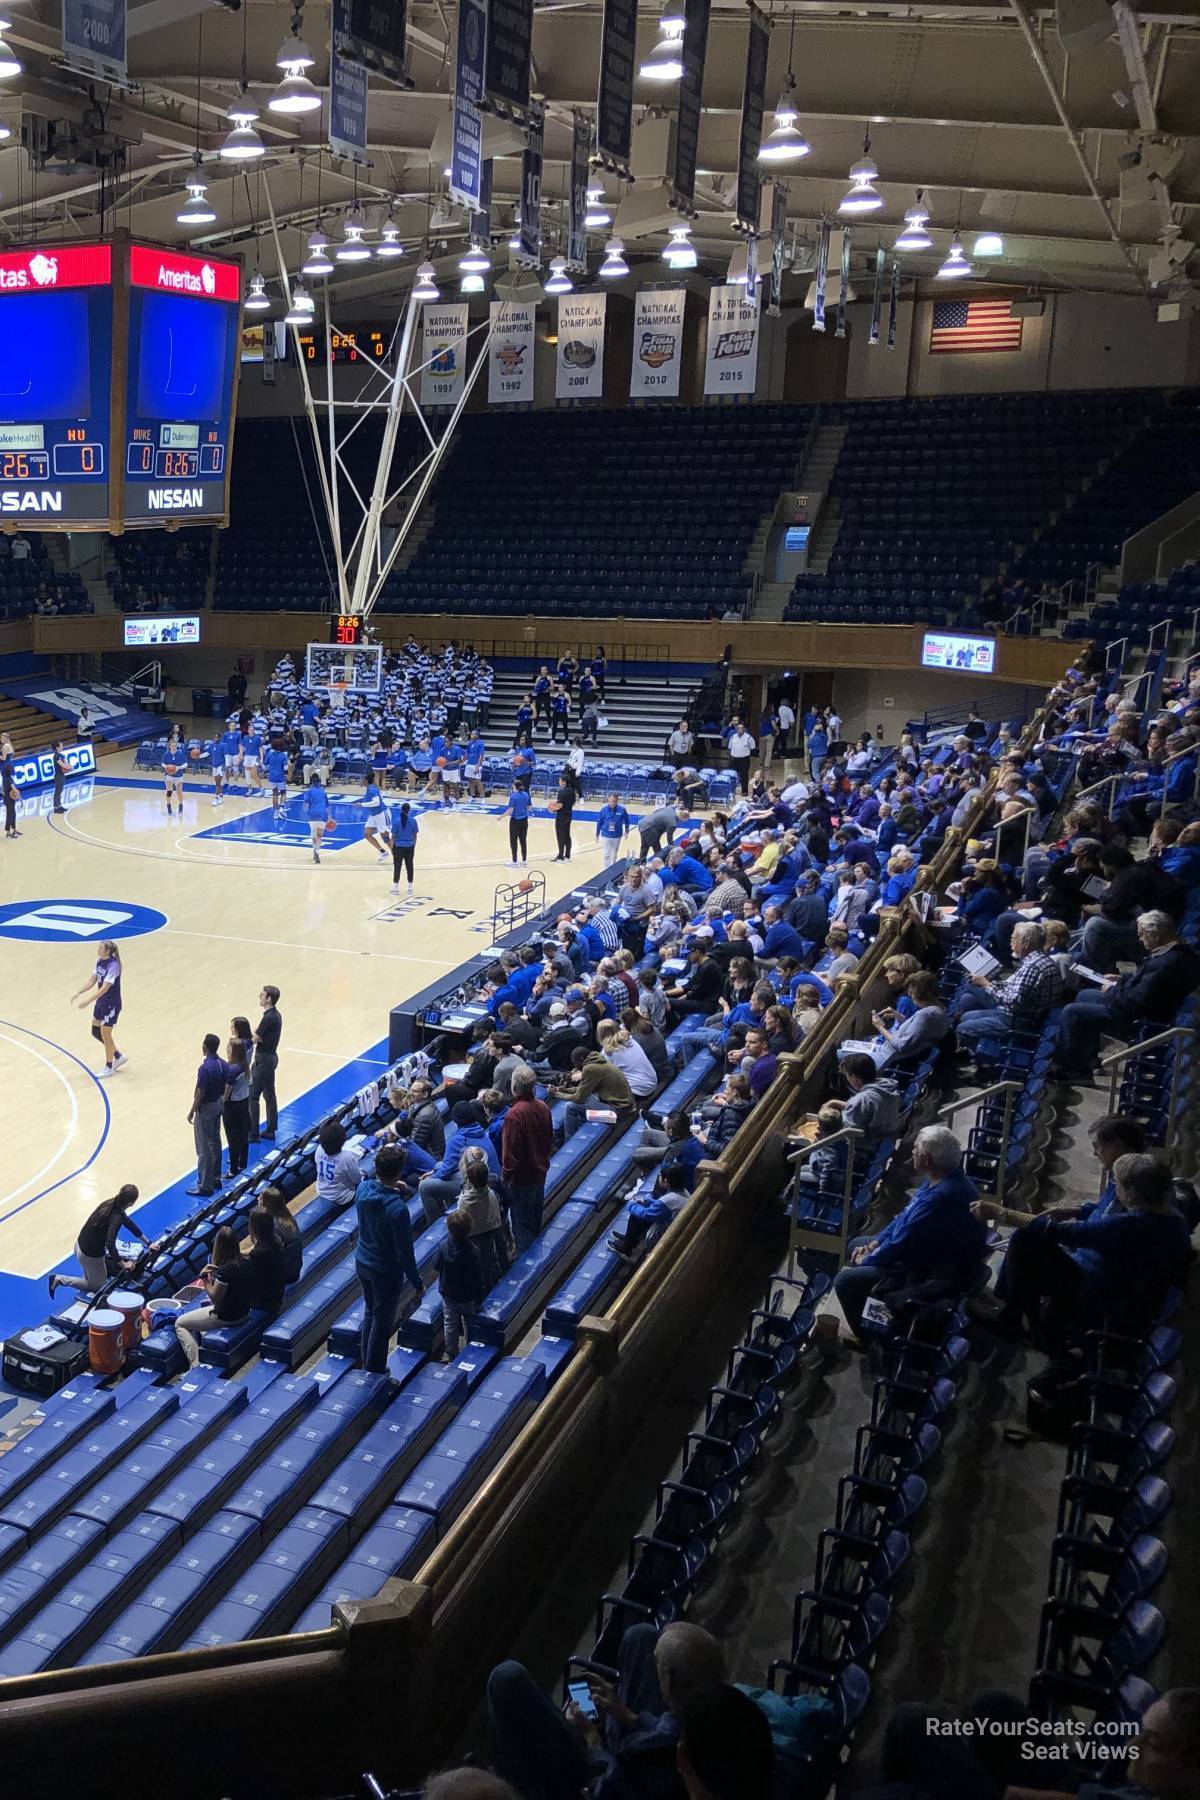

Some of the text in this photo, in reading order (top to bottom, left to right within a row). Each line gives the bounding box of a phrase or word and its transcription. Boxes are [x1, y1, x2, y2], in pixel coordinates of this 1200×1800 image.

[82, 17, 110, 45] 2000
[158, 264, 202, 292] Ameritas
[429, 316, 462, 326] NATIONAL
[712, 310, 758, 321] CHMIONS
[425, 328, 465, 338] CHAMPIONS
[308, 346, 315, 359] 0
[376, 343, 383, 356] 0
[568, 376, 590, 386] 2001
[644, 375, 667, 385] 2010
[720, 371, 743, 381] 2015
[433, 384, 453, 393] 1991
[501, 382, 522, 391] 1992
[68, 430, 86, 441] NU
[134, 429, 152, 441] DUKE
[208, 431, 218, 442] NU
[81, 447, 94, 472] 0
[142, 447, 150, 471] 0
[164, 454, 189, 476] 8:26
[212, 448, 220, 470] 0
[148, 489, 203, 510] NISSAN
[338, 616, 359, 628] 8:26
[336, 627, 355, 644] 30
[41, 750, 91, 779] GCO
